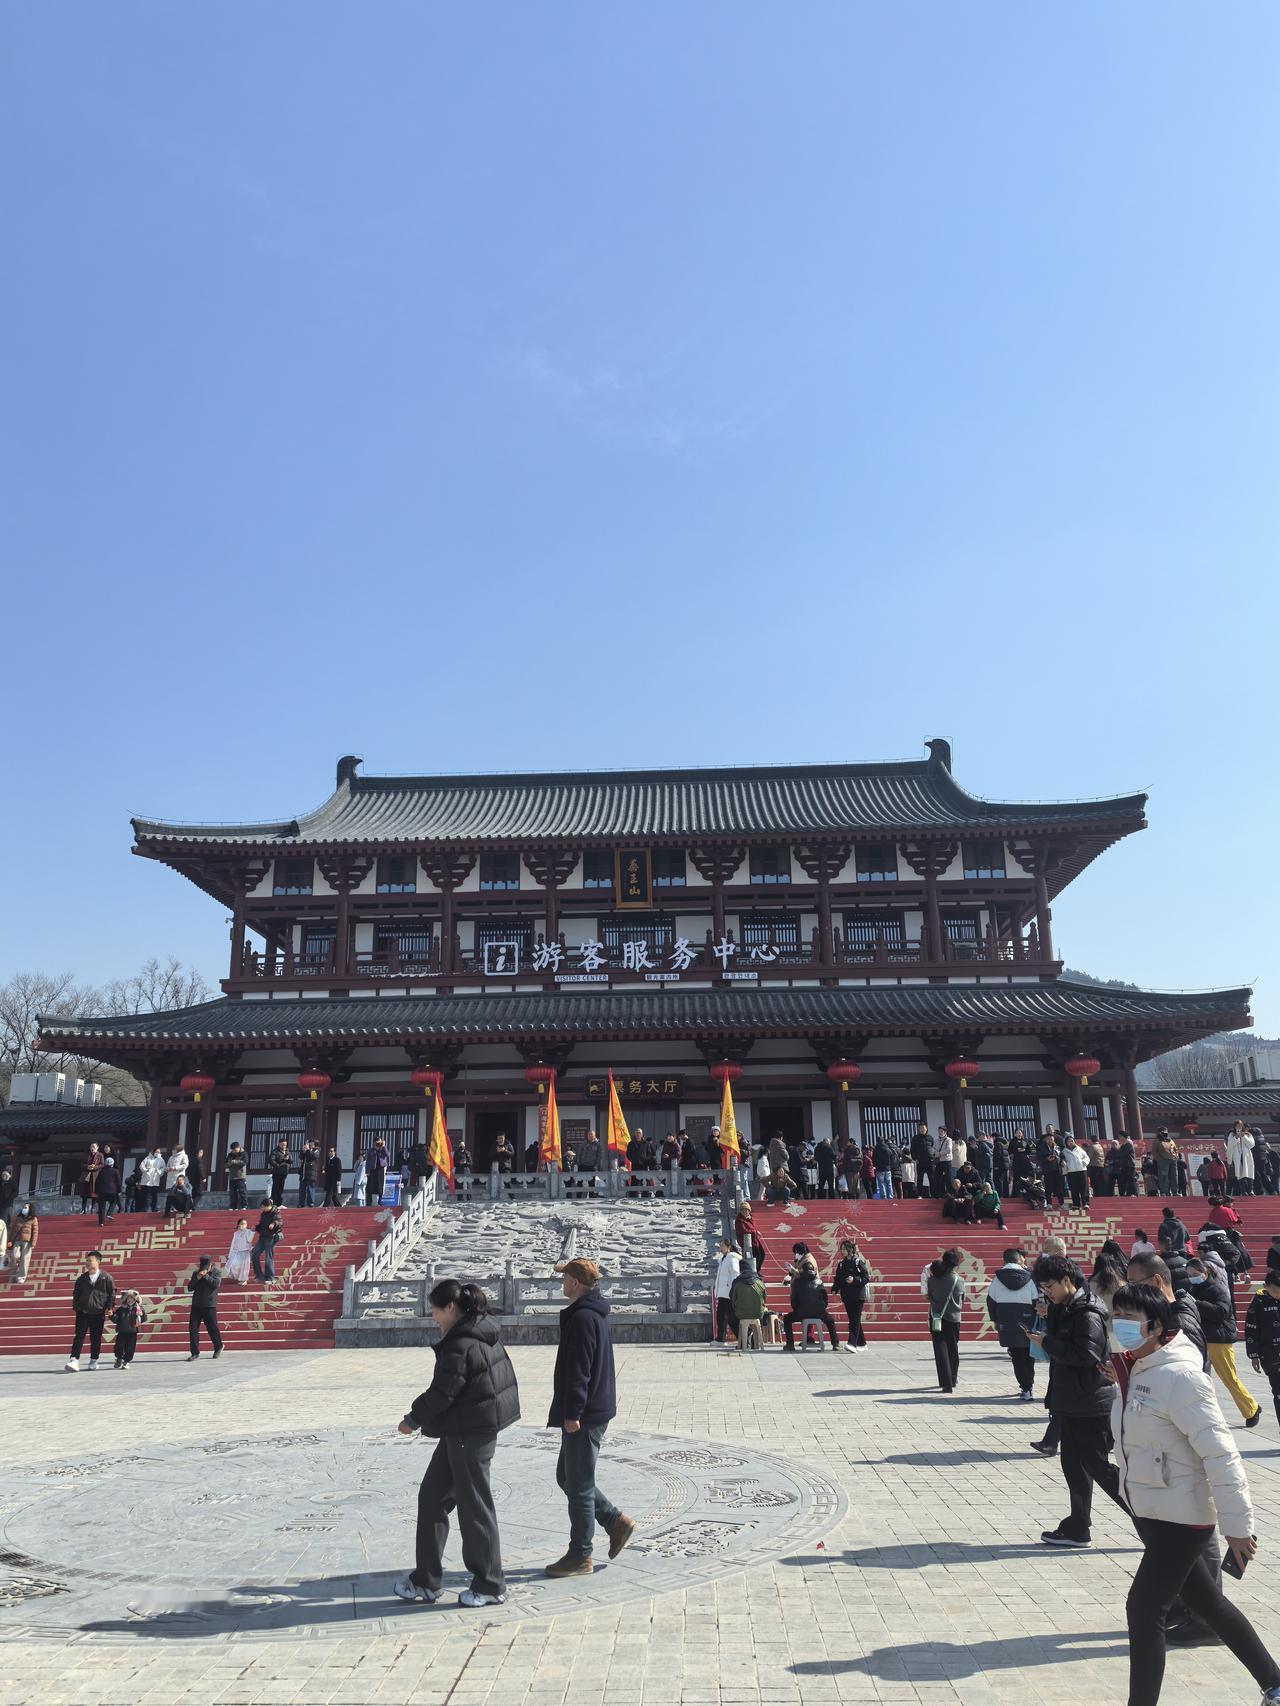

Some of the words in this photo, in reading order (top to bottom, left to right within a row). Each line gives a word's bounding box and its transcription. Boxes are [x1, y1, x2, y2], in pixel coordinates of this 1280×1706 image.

[531, 937, 780, 973] 游客服务中心
[582, 974, 608, 982] CENTER
[613, 1080, 677, 1094] 票务大厅
